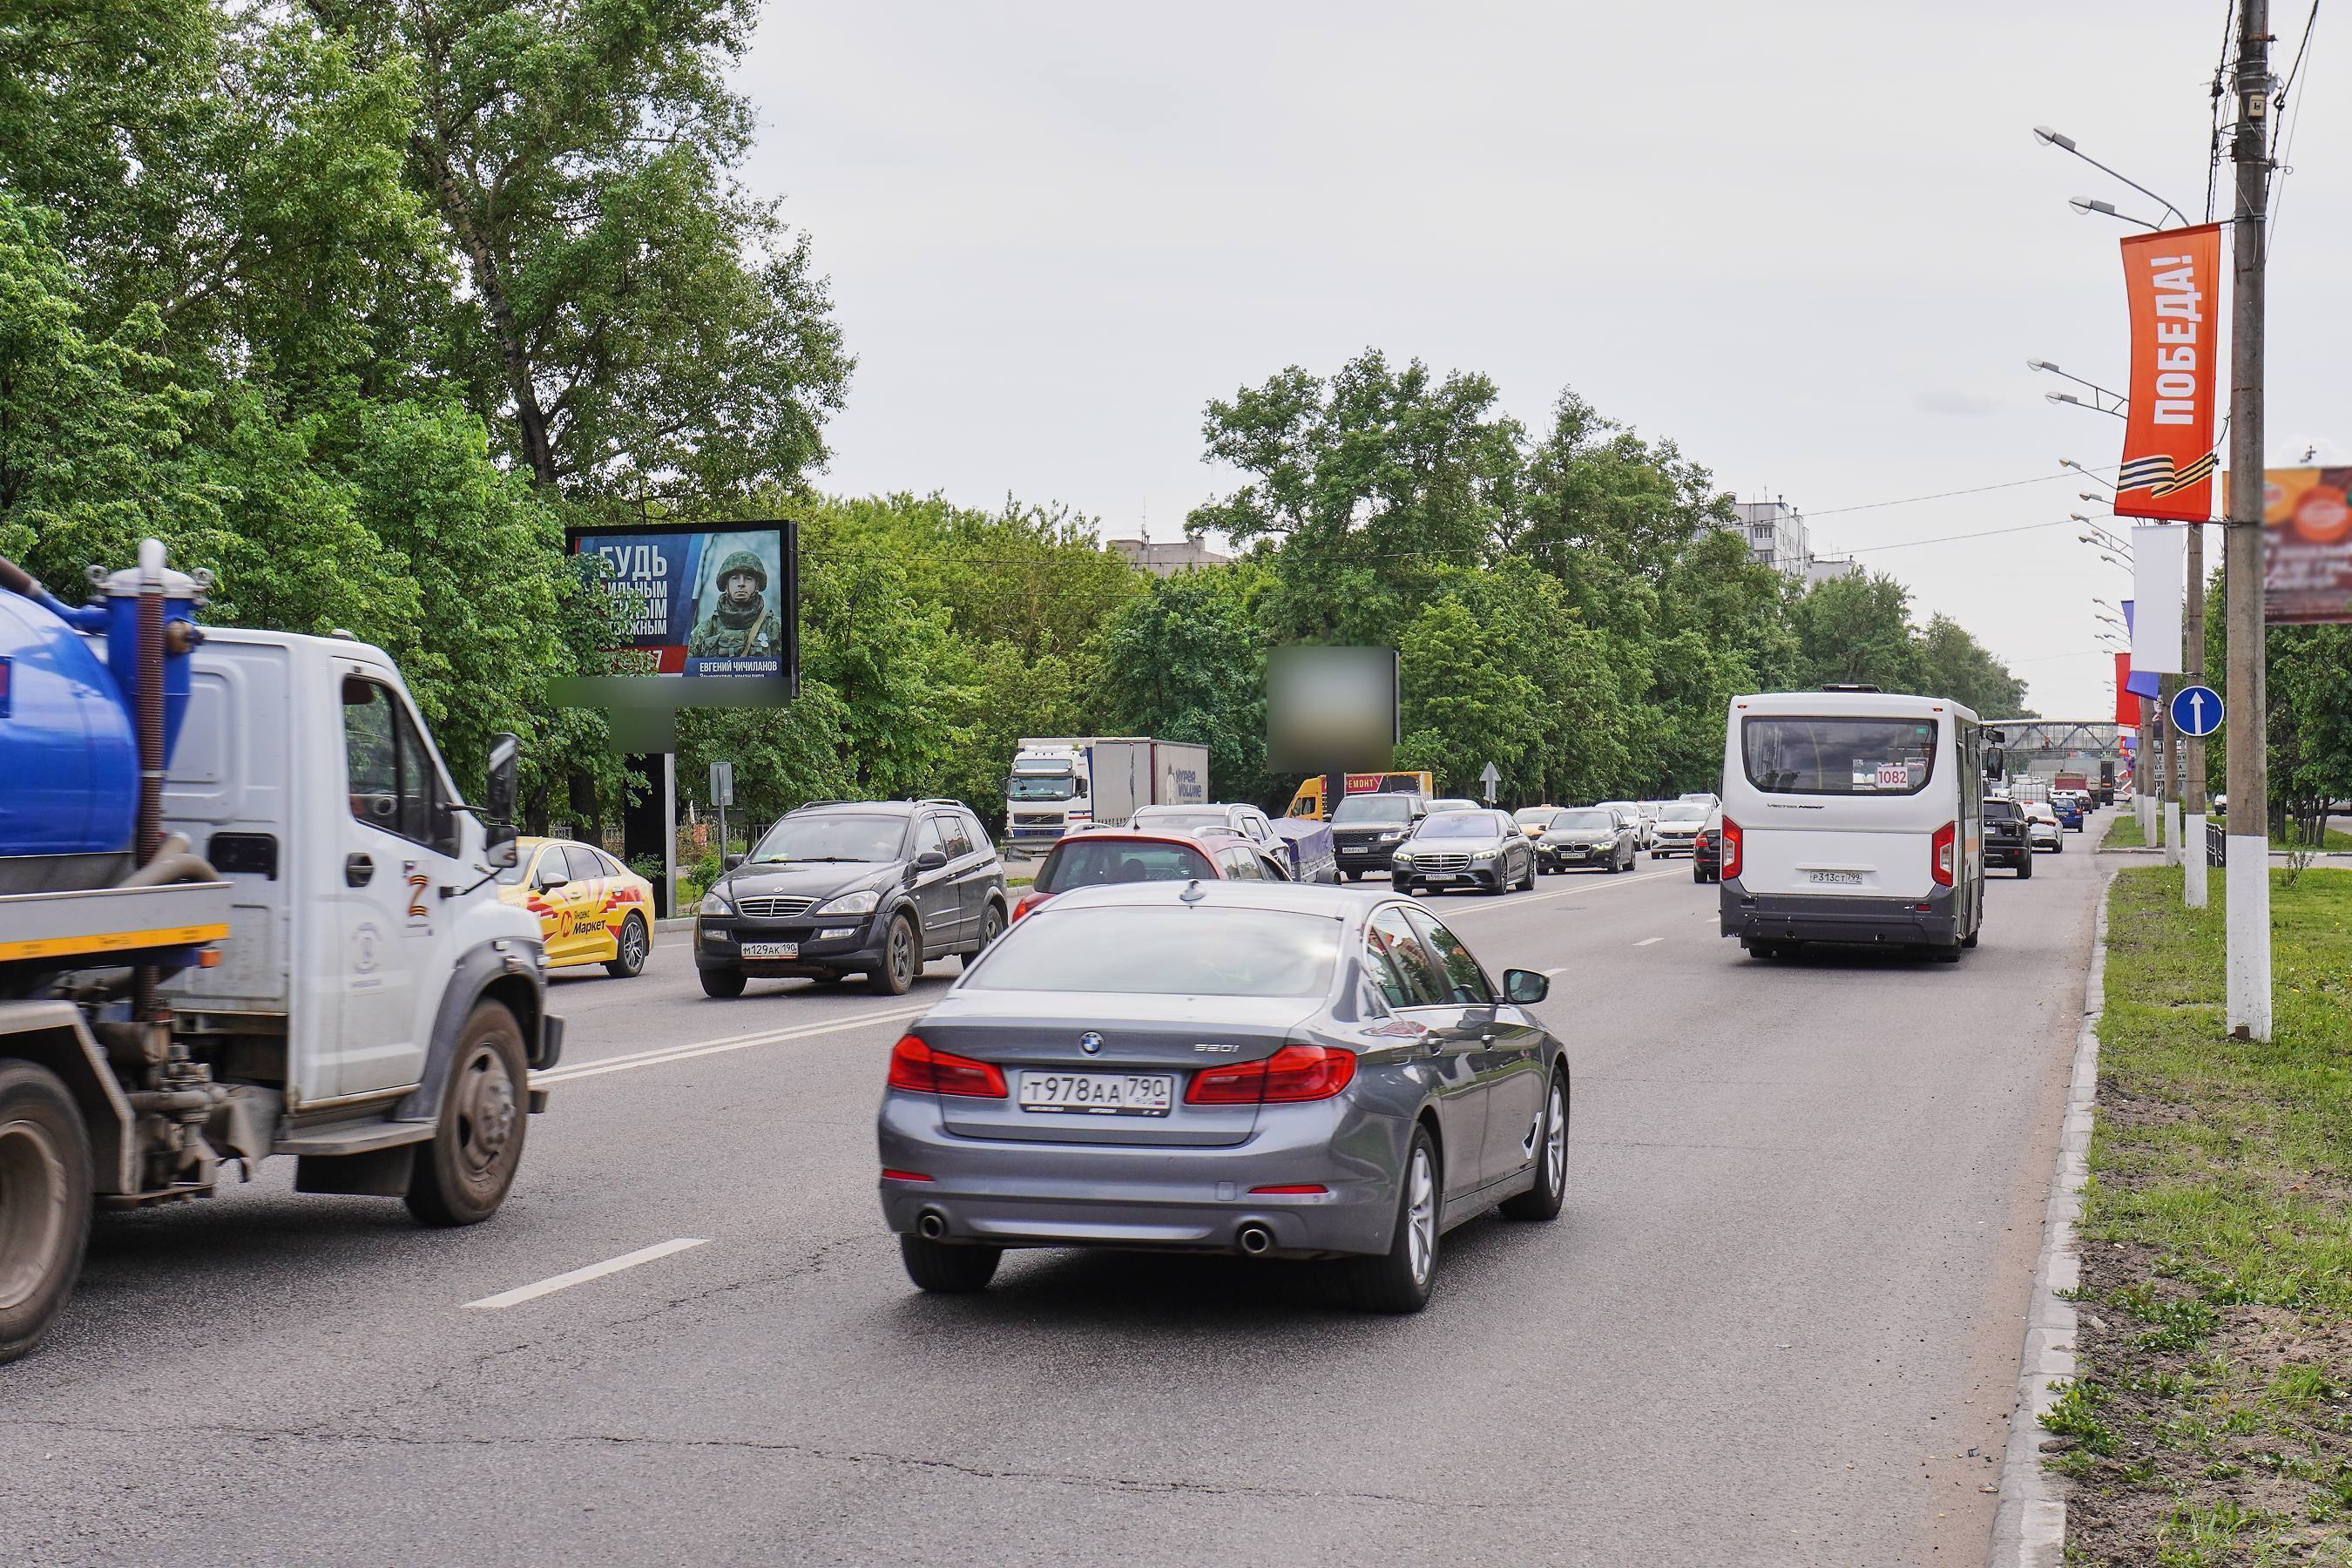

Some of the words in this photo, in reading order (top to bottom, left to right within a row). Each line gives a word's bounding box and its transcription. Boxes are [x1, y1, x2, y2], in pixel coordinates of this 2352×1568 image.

[2150, 254, 2202, 425] ПОБЕДА!
[599, 545, 667, 581] БУДЬ
[700, 659, 732, 672] ЕВГЕНИЙ
[733, 660, 778, 672] ЧИЧИЛАНОВ
[1878, 771, 1907, 784] 1082
[572, 920, 605, 935] Маркет
[1031, 1077, 1120, 1103] Т978АА
[1128, 1078, 1164, 1097] 790
